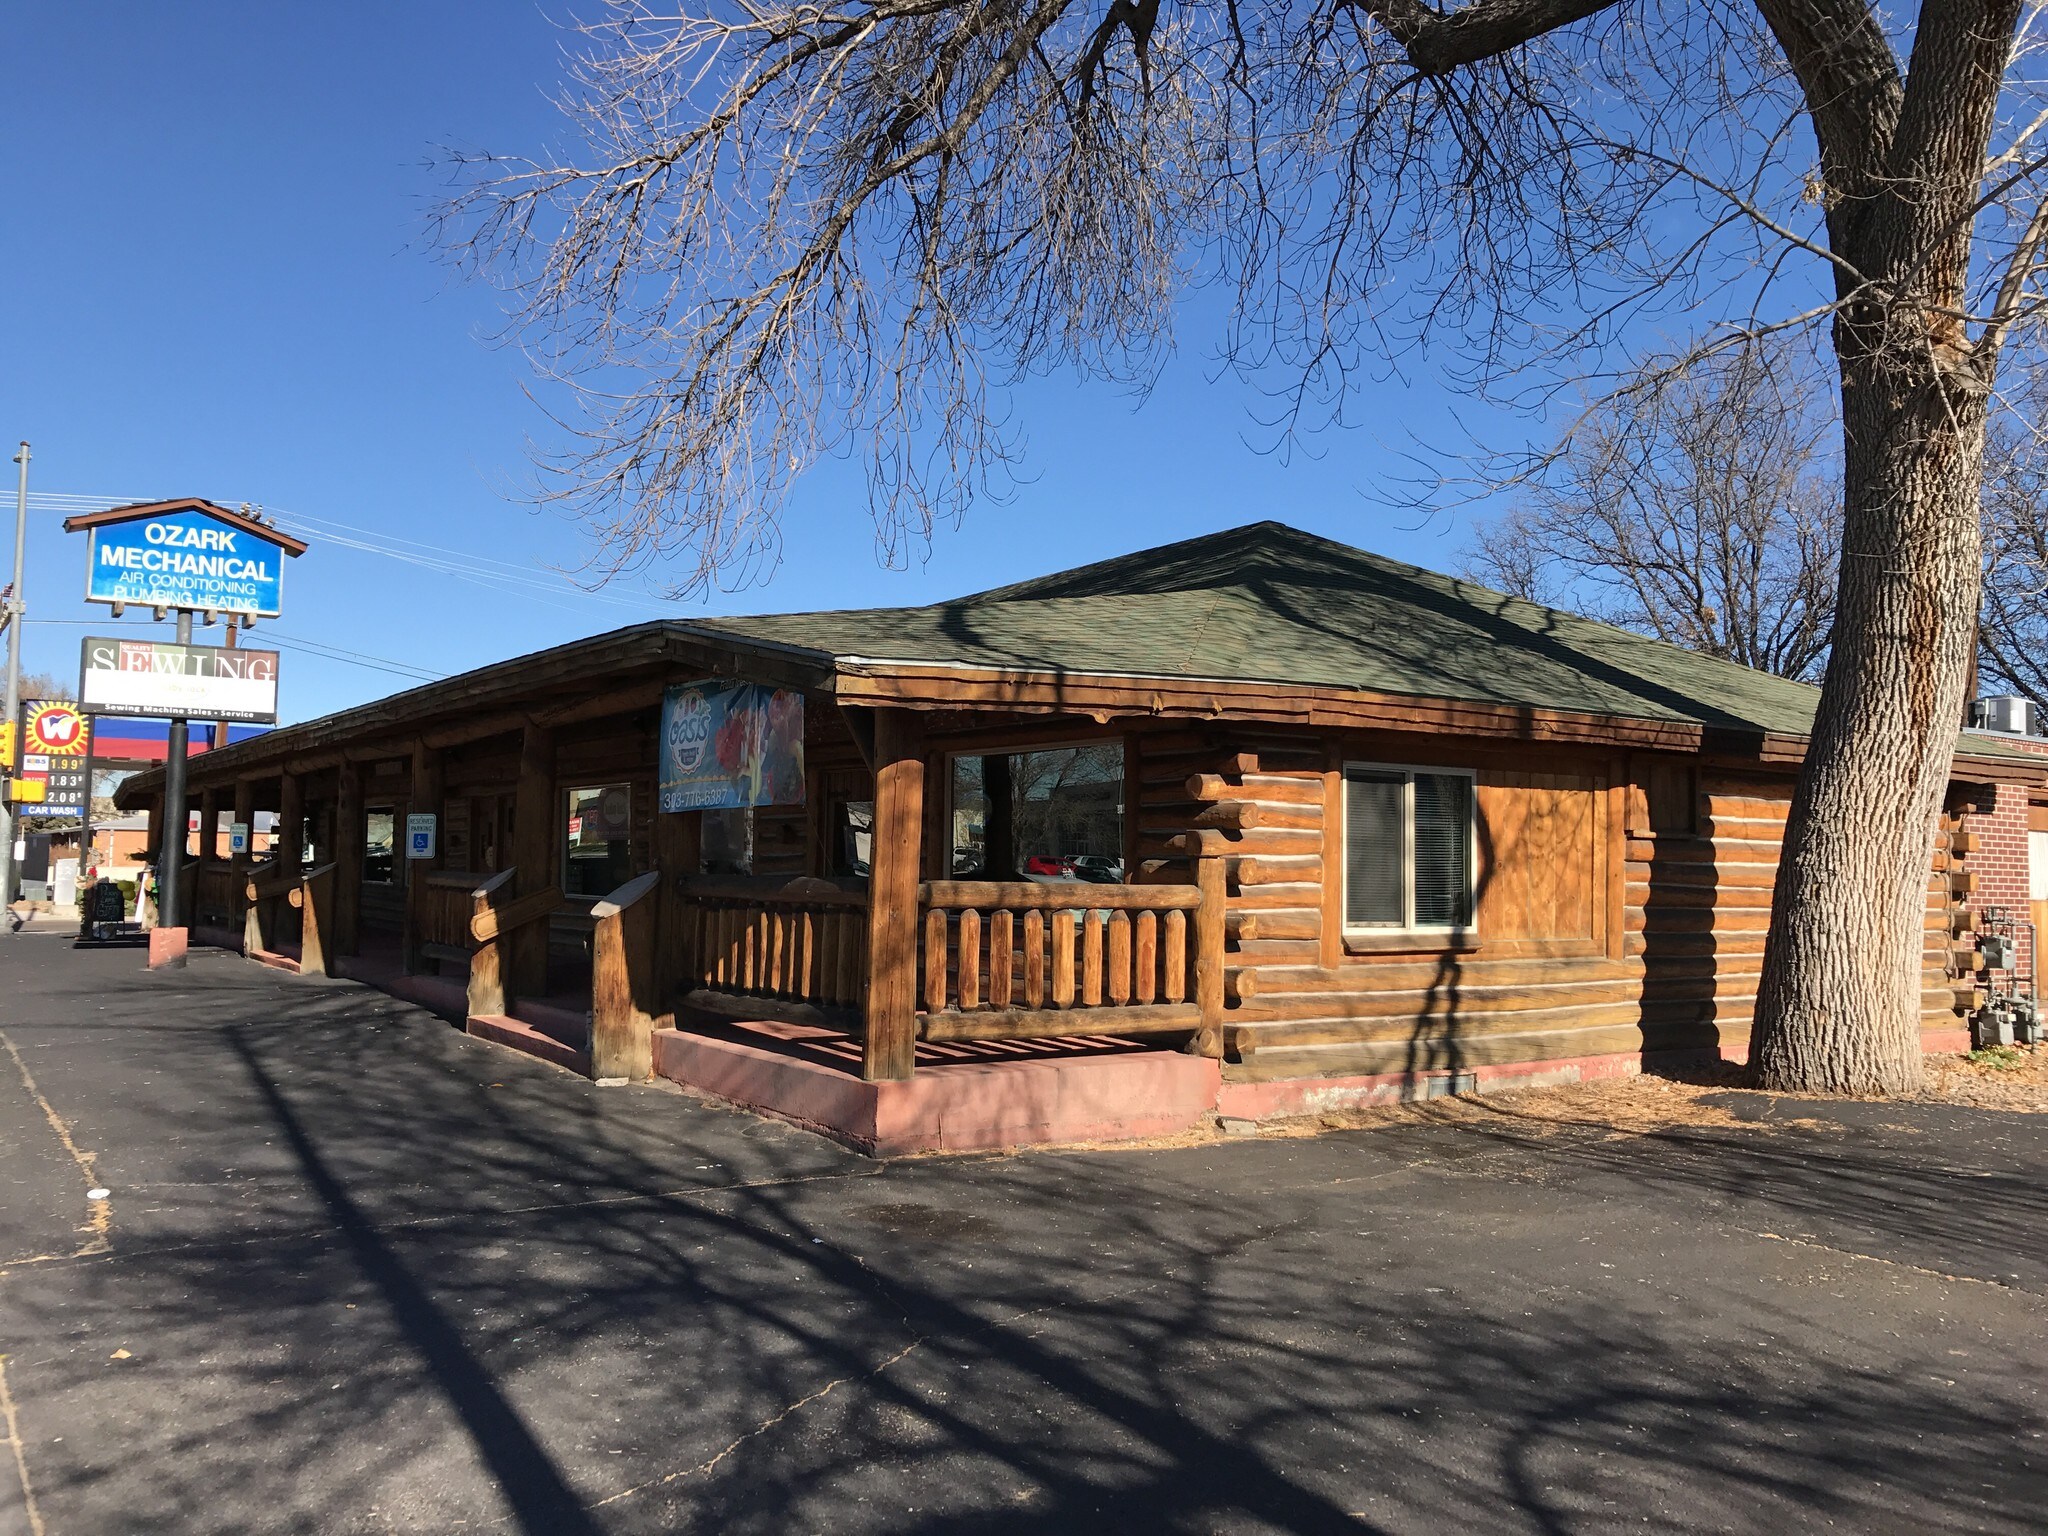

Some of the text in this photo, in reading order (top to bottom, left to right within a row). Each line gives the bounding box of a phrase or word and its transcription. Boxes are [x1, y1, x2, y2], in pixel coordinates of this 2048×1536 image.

[145, 523, 237, 552] OZARK
[101, 545, 274, 582] MECHANICAL
[119, 571, 256, 595] AIR CONDITIONING
[113, 585, 259, 610] PLUMBING HEATING
[122, 644, 152, 652] QUALITY
[92, 647, 275, 681] SEWING
[104, 703, 254, 718] Sewing Machine Sales Service
[28, 806, 77, 815] CAR WASH
[664, 789, 728, 809] 303-776-6387
